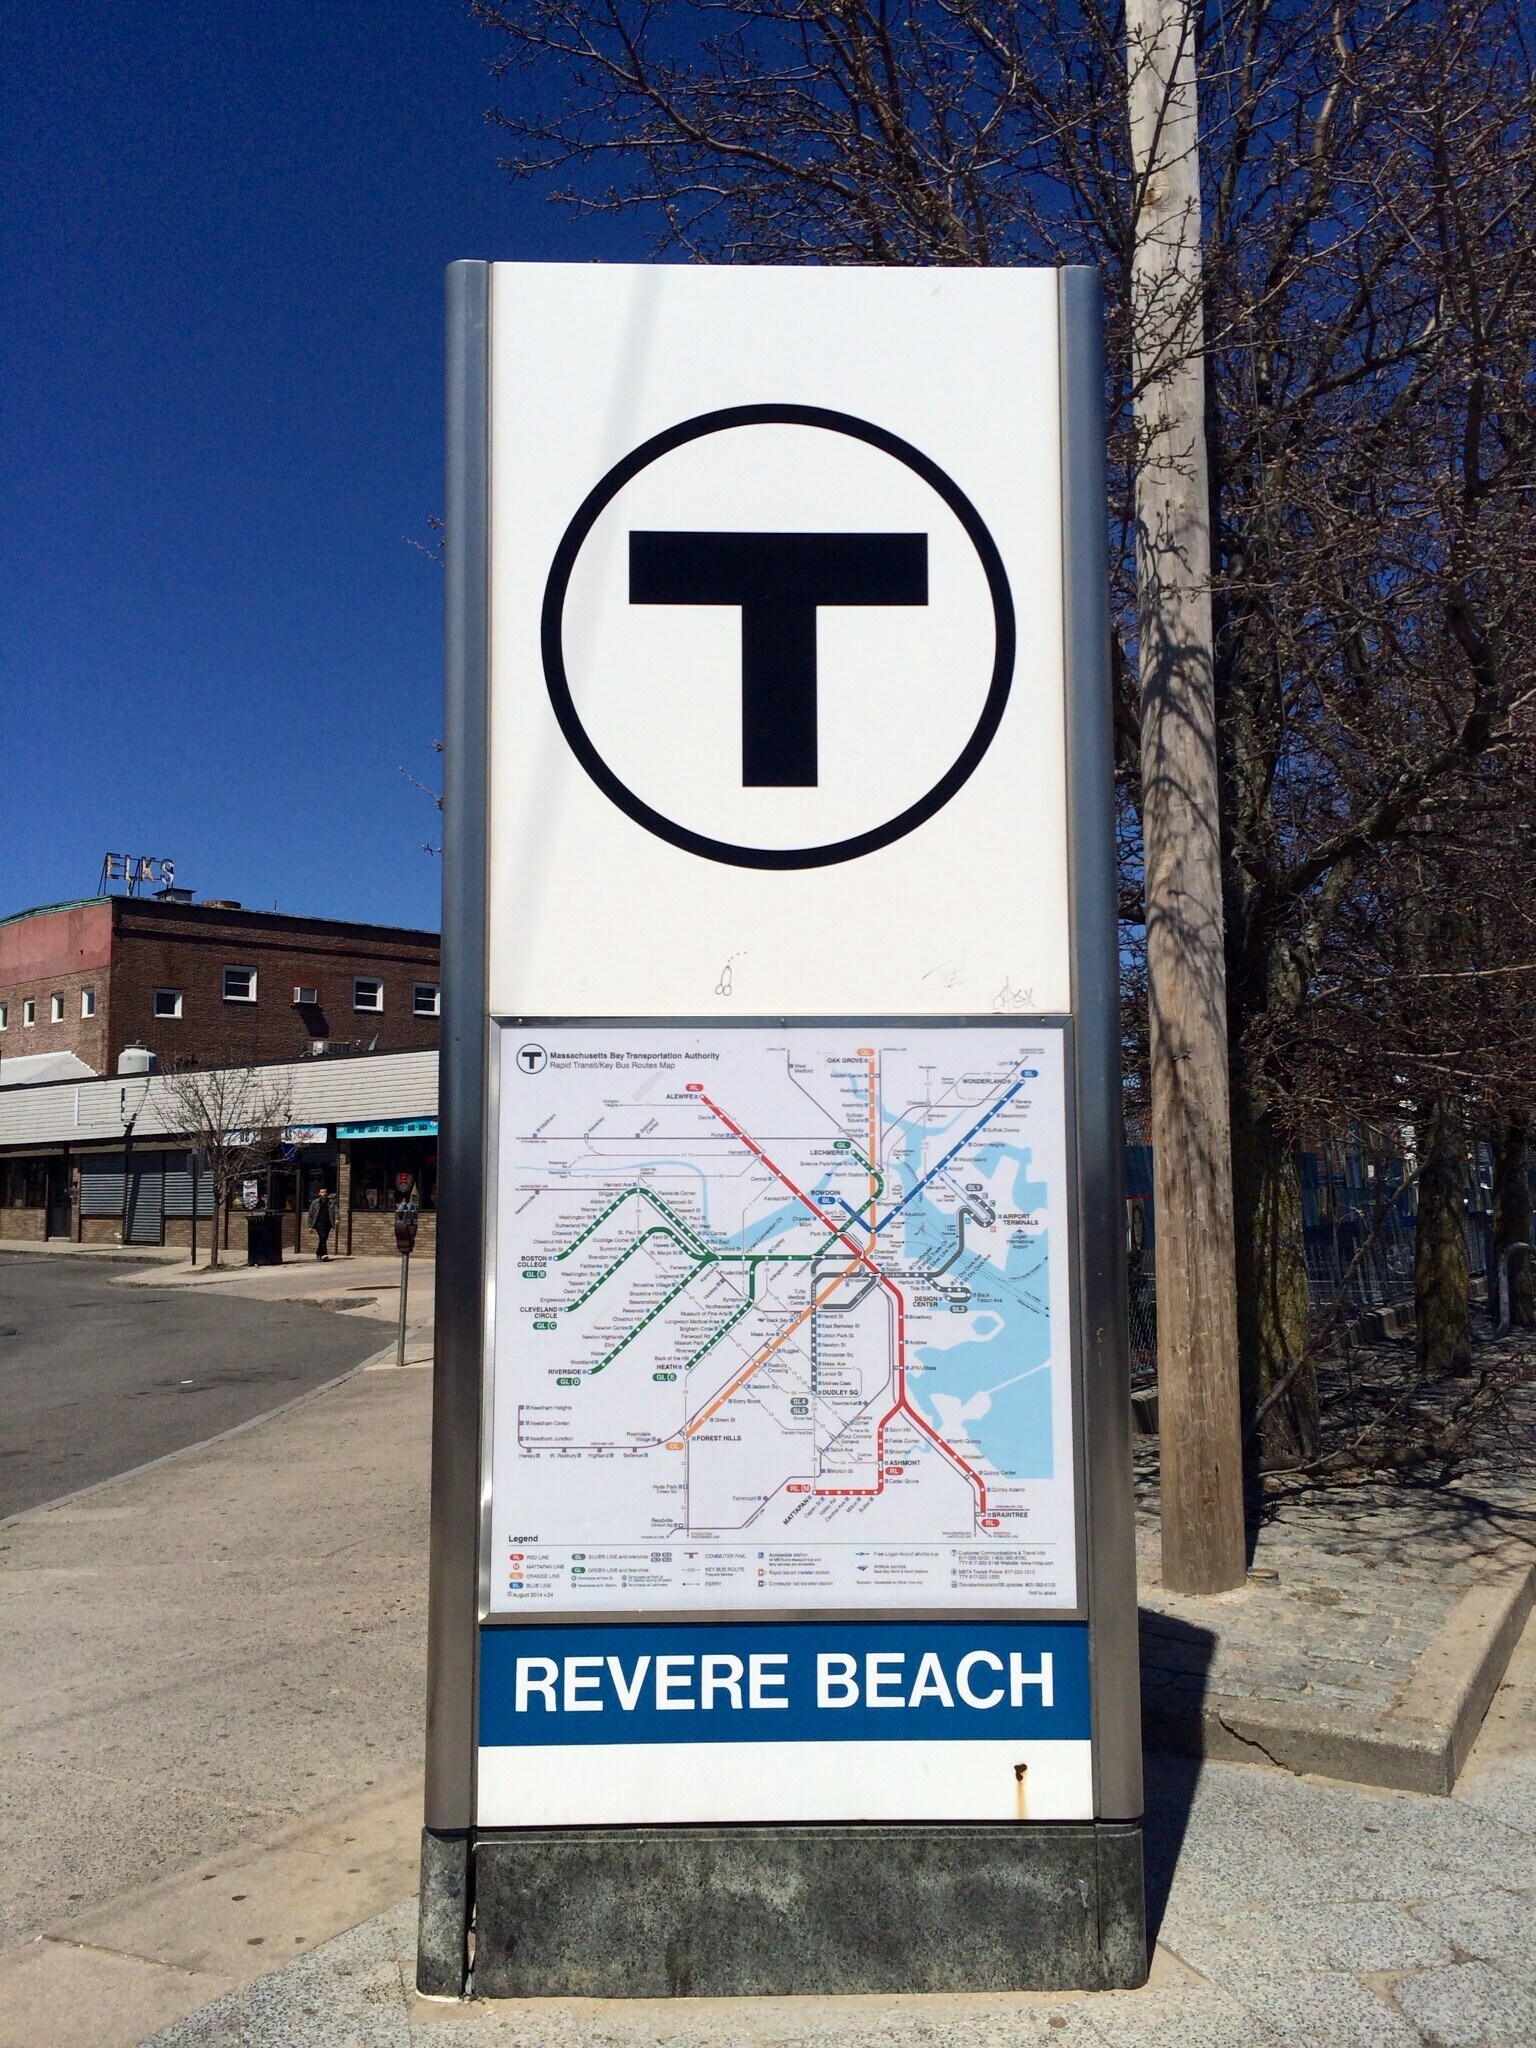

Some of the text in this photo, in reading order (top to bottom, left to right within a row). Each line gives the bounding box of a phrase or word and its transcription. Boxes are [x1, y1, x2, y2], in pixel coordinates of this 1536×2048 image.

[629, 530, 928, 787] T
[106, 853, 175, 884] ELKS
[522, 1052, 542, 1069] T
[550, 1052, 720, 1062] Massachusetts Bay Transportation Authority
[550, 1061, 676, 1072] Rapid Transit/Key Bus Routes Map
[783, 1498, 809, 1525] MATTAPAN
[508, 1535, 539, 1545] Legend
[515, 1651, 1054, 1711] REVERE BEACH
